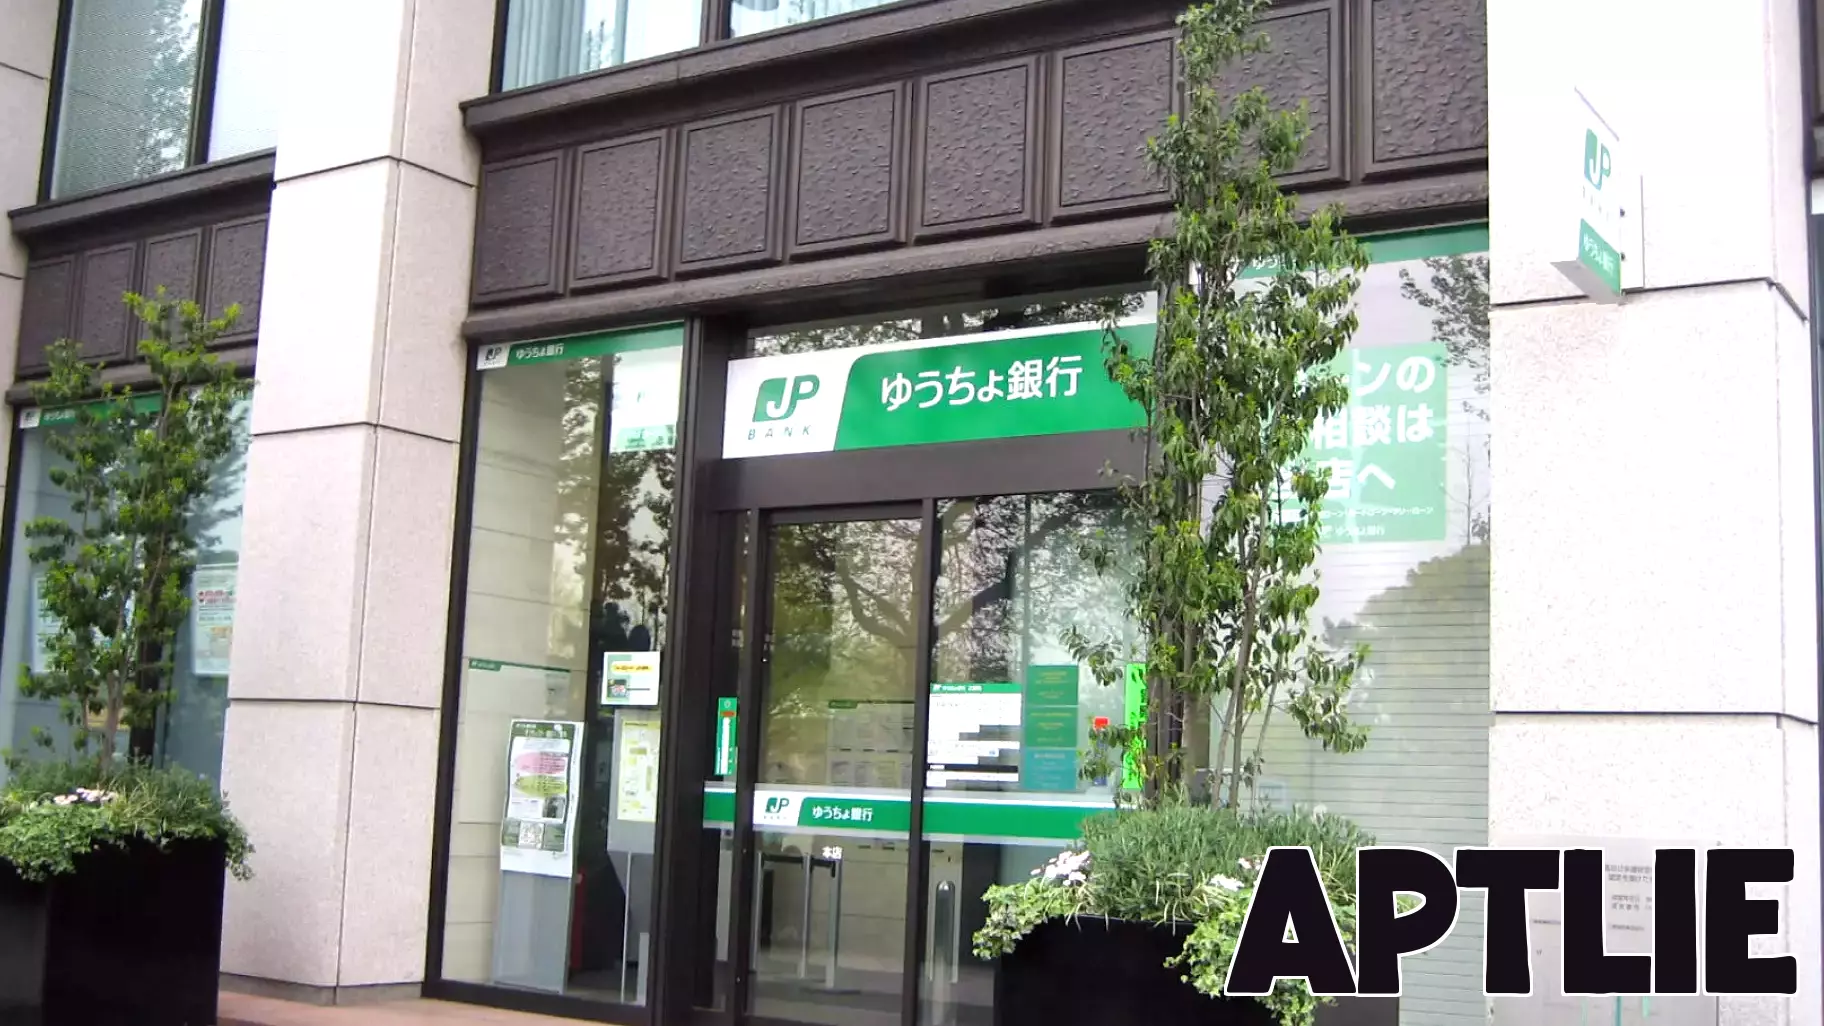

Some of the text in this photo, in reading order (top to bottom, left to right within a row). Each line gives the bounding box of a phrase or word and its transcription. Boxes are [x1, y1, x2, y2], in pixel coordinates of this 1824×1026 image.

[1584, 127, 1611, 191] JP
[881, 355, 1083, 412] ゆうちょ銀行
[752, 374, 820, 422] JP
[747, 424, 812, 441] BANK
[765, 797, 790, 813] JP
[812, 805, 873, 822] ゆうちょ銀行
[822, 846, 843, 860] 本店
